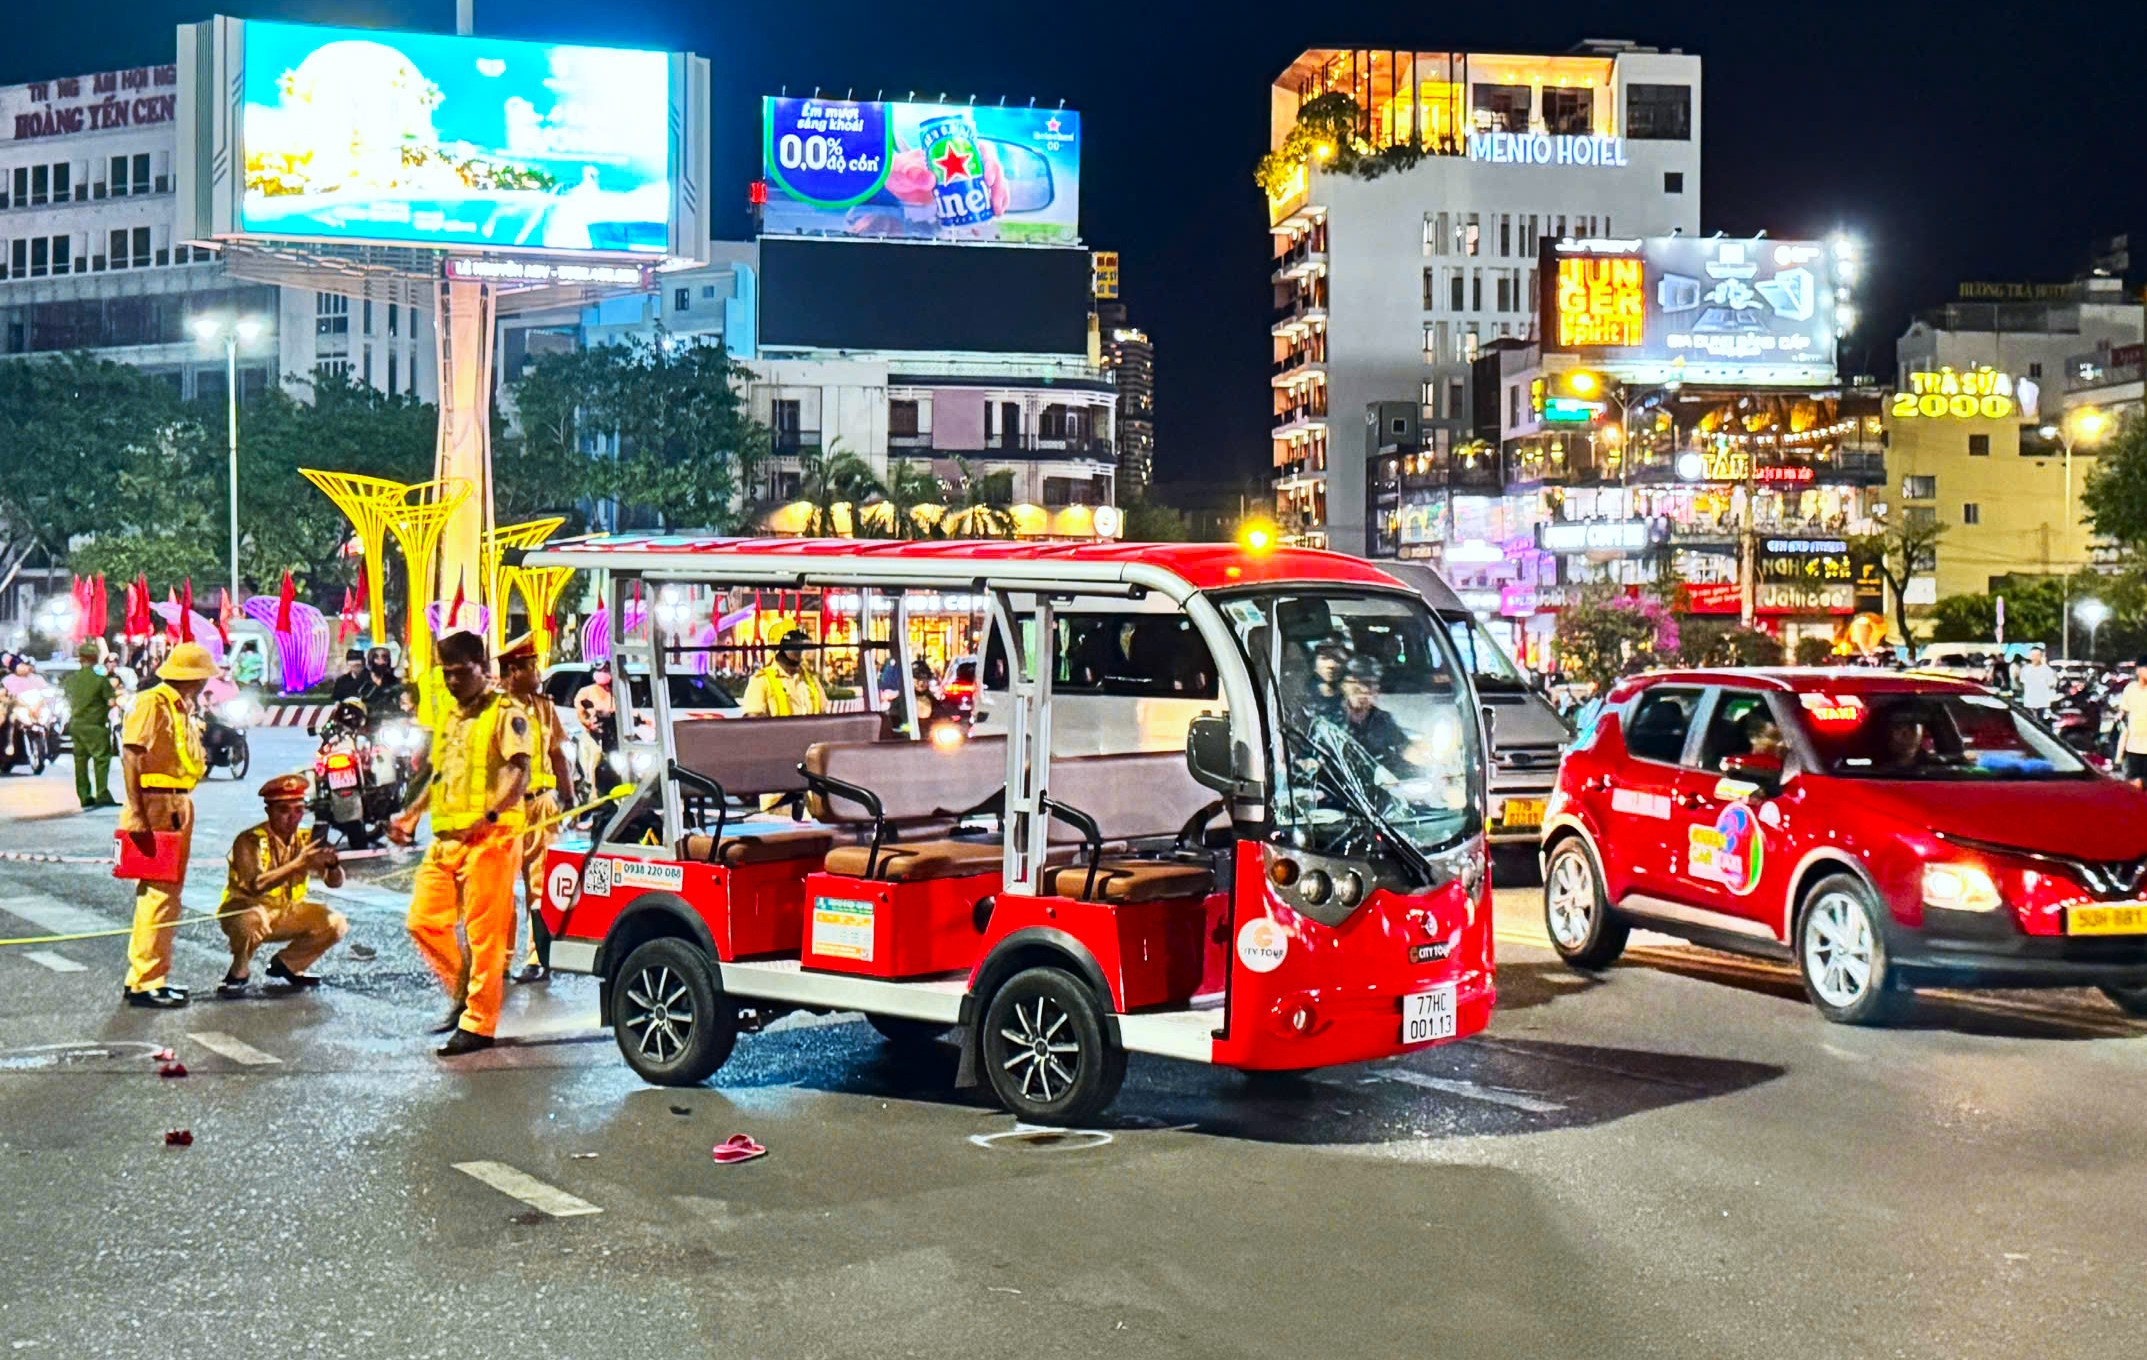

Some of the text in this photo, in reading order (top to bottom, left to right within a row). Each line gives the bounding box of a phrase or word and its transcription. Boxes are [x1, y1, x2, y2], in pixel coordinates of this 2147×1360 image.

[1470, 132, 1628, 166] MENTO HOTEL
[1910, 365, 2013, 397] TRÀ SỮA
[1892, 392, 2013, 418] 2000
[623, 863, 645, 875] 0938
[647, 865, 663, 877] 220
[556, 876, 574, 898] 12
[1417, 993, 1447, 1015] 77HC
[1410, 1015, 1452, 1040] 001.13
